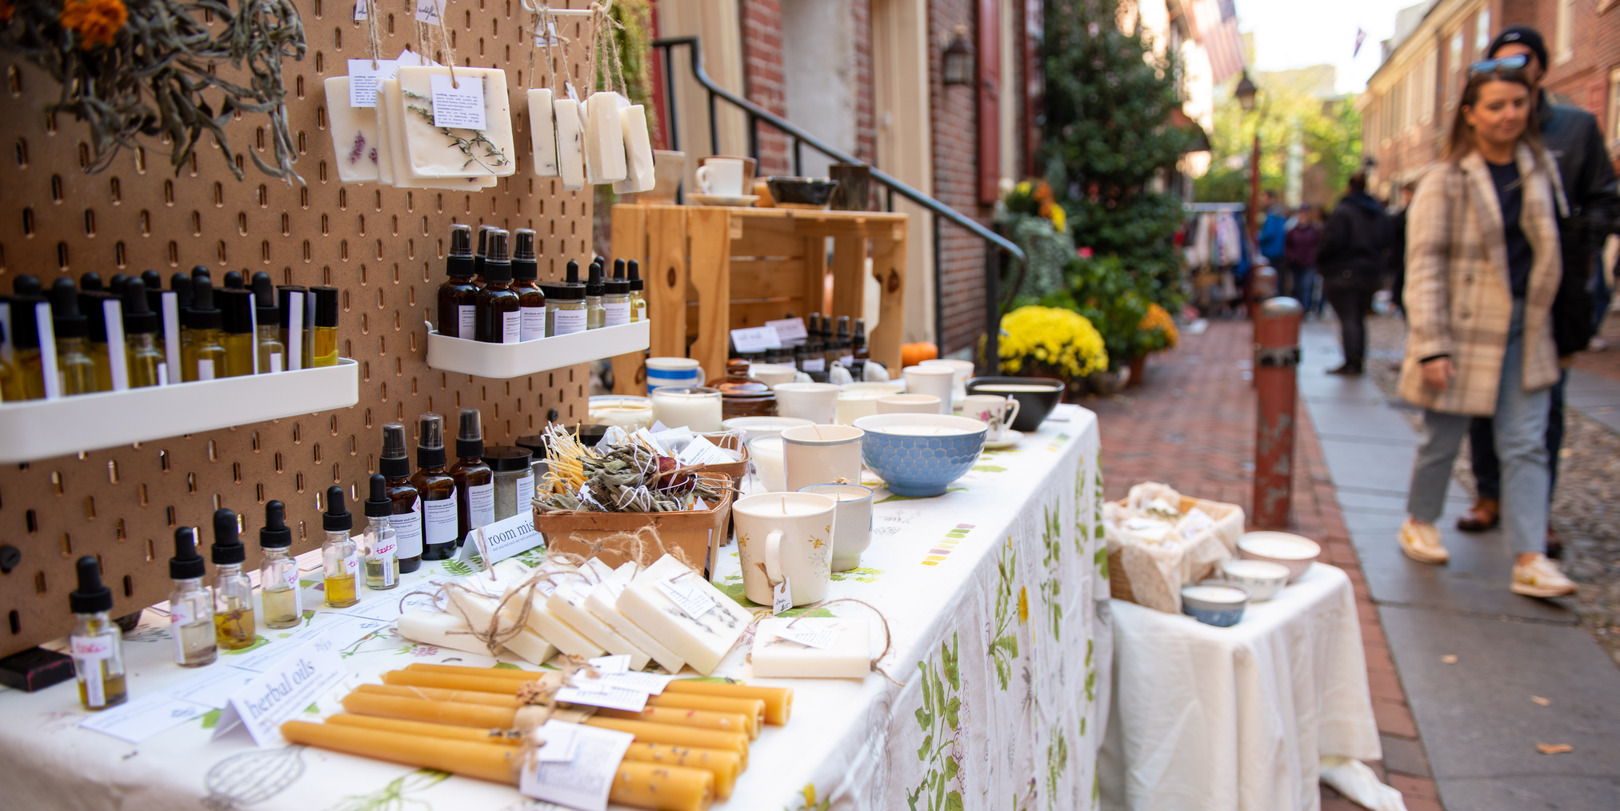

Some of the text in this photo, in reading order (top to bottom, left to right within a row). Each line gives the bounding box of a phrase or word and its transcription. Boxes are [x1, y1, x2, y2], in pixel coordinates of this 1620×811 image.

[487, 527, 517, 547] room
[516, 519, 534, 536] mis
[243, 671, 293, 719] herbal
[292, 658, 316, 685] oils
